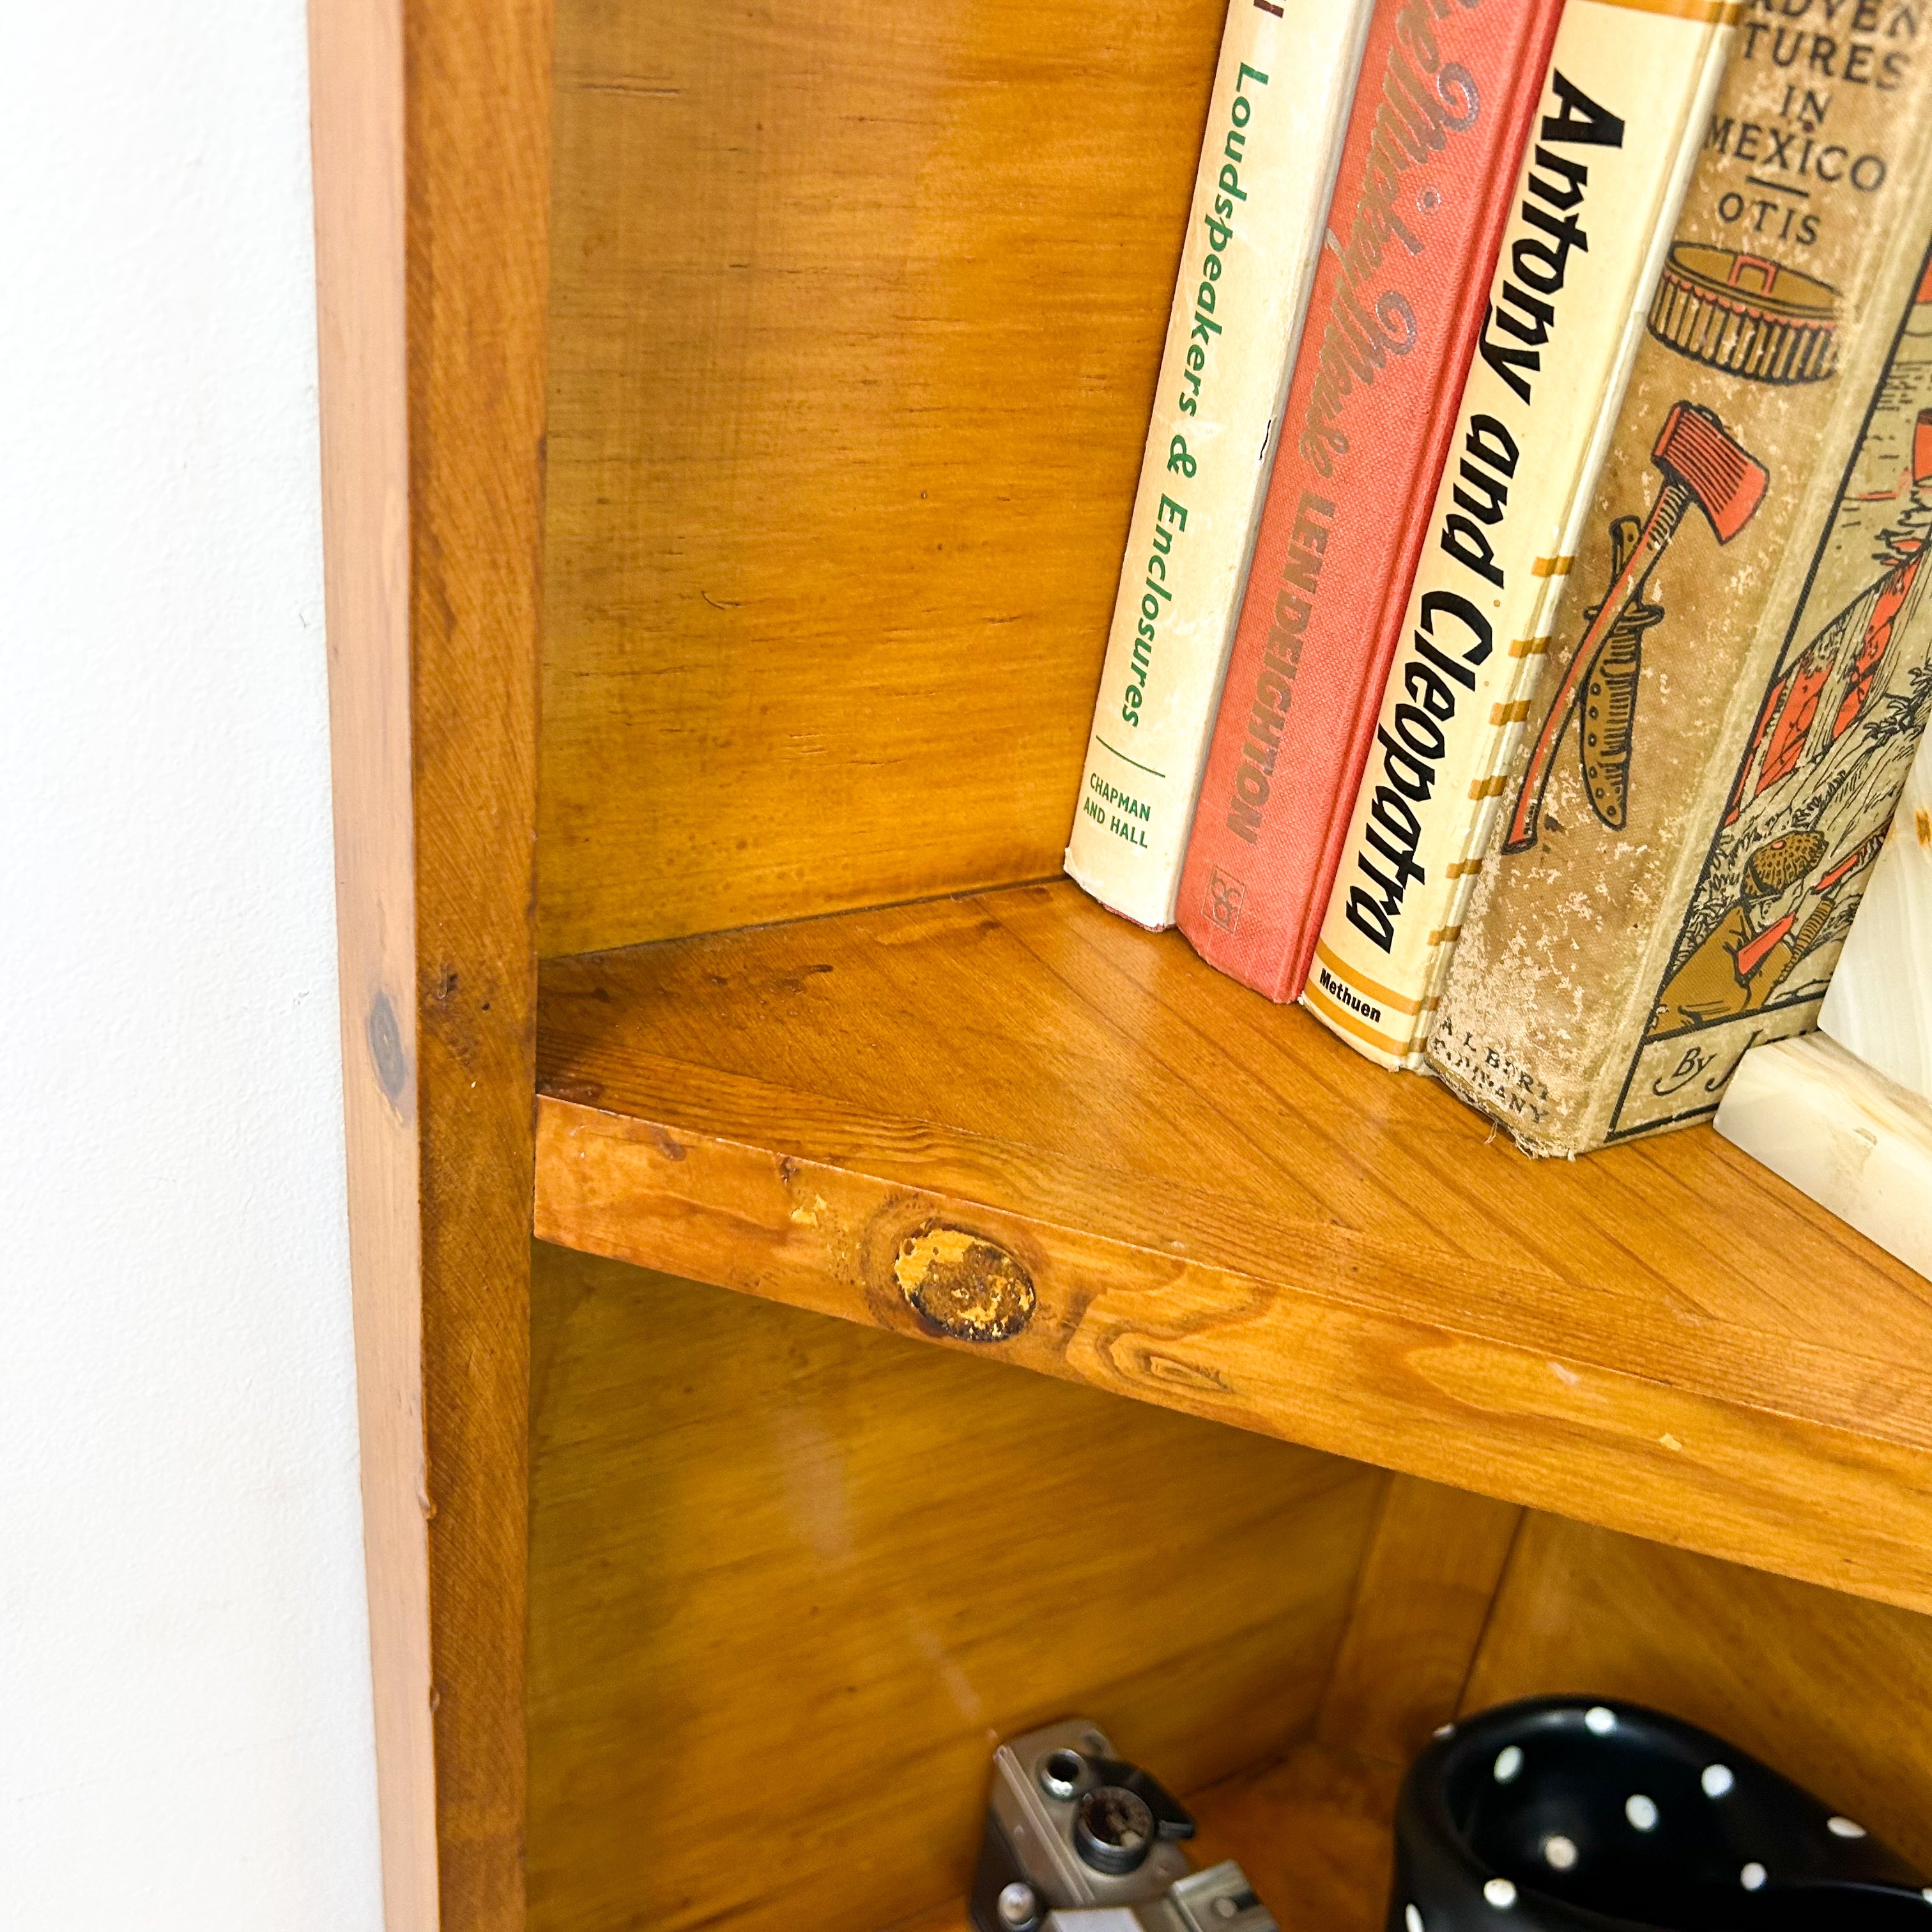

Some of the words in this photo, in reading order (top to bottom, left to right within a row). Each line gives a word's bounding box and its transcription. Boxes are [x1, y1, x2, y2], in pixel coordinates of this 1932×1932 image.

[1744, 20, 1912, 90] TURES
[1780, 84, 1832, 123] IN
[1703, 115, 1887, 192] MEXICO
[1179, 62, 1269, 416] Loudspeakers
[1479, 67, 1625, 406] Antony
[1719, 192, 1821, 245] OTIS
[1299, 275, 1416, 478] Mouse
[1167, 434, 1197, 478] &
[1440, 413, 1520, 590] and
[1277, 490, 1335, 595] LEN
[1123, 493, 1188, 728] Enclosures
[1225, 590, 1313, 845] DEIGHTON
[1090, 772, 1151, 822] CHAPMAN
[1346, 590, 1493, 954] Cleopatra
[1083, 797, 1106, 825] AND
[1109, 816, 1148, 849] HALL
[1319, 968, 1381, 1023] Methuen
[1652, 1046, 1718, 1096] By
